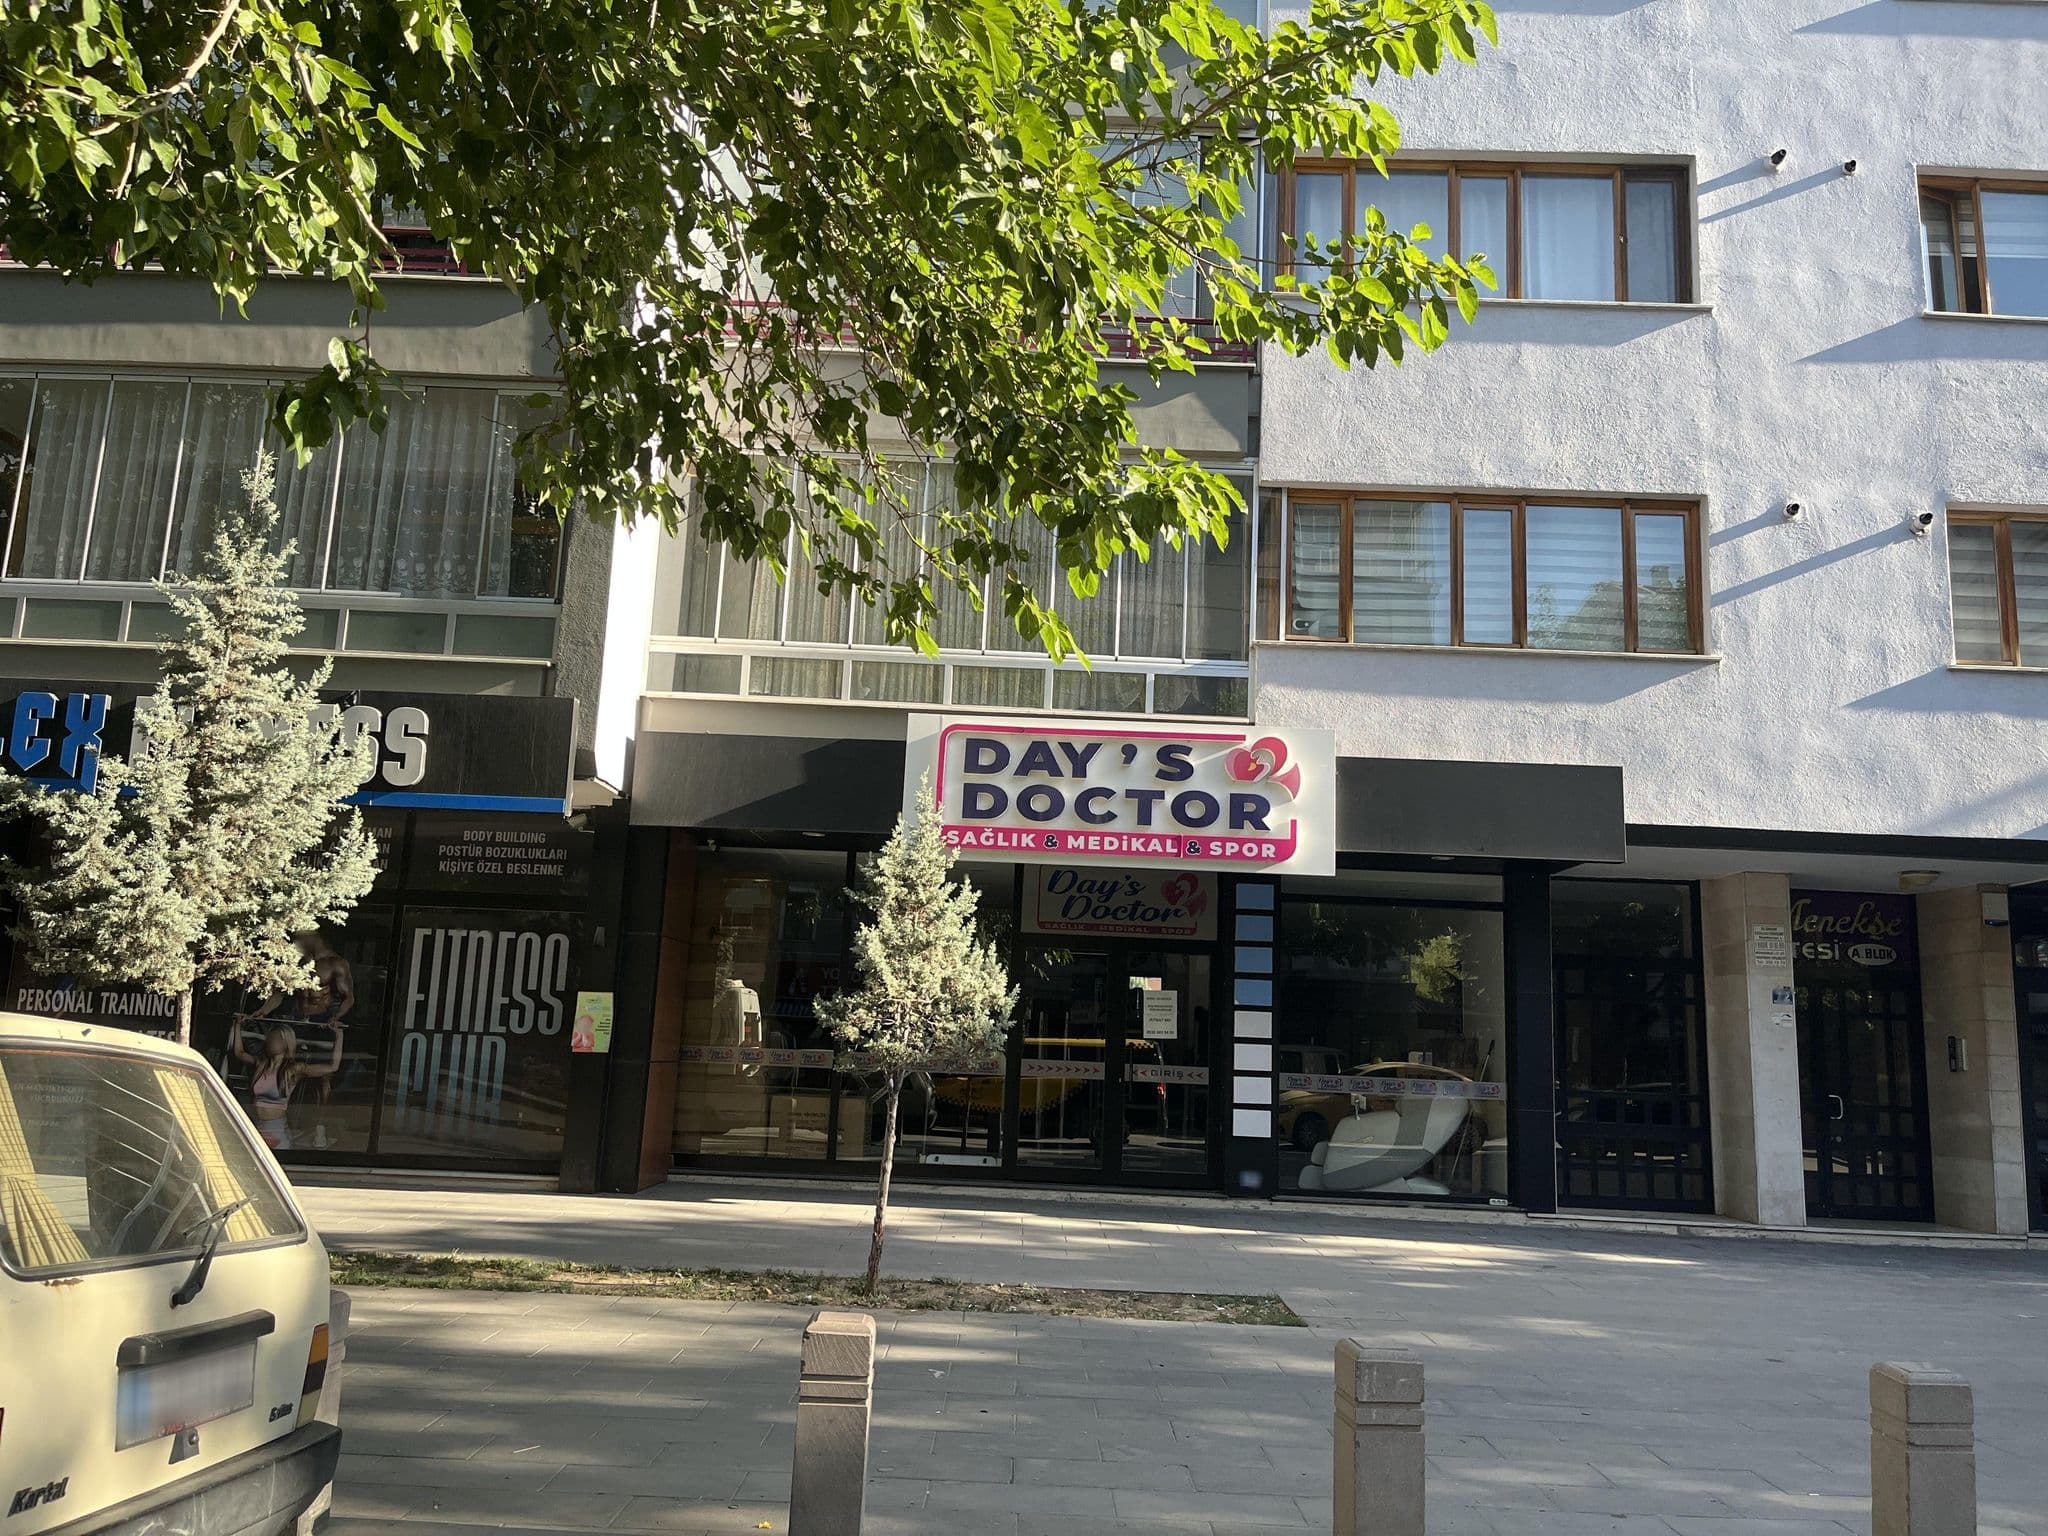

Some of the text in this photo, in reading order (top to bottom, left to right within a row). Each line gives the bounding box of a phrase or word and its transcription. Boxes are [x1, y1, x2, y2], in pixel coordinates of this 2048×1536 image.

[0, 691, 112, 796] EX
[961, 782, 1271, 831] DOCTOR
[438, 843, 568, 861] POSTÜR BOZUKLUKLARI
[463, 830, 546, 844] BODY BUILDING
[945, 828, 1036, 849] SAĞLIK
[1043, 834, 1059, 850] &
[1185, 840, 1201, 855] &
[1209, 841, 1276, 859] SPOR
[439, 859, 564, 876] KİŞİYE ÖZEL BESLENME
[1047, 870, 1146, 903] Day's
[1061, 895, 1187, 922] Doctor
[404, 927, 570, 1036] FITNESS
[16, 988, 175, 1017] PERSONAL TRAINING
[7, 1476, 69, 1518] Kartal
